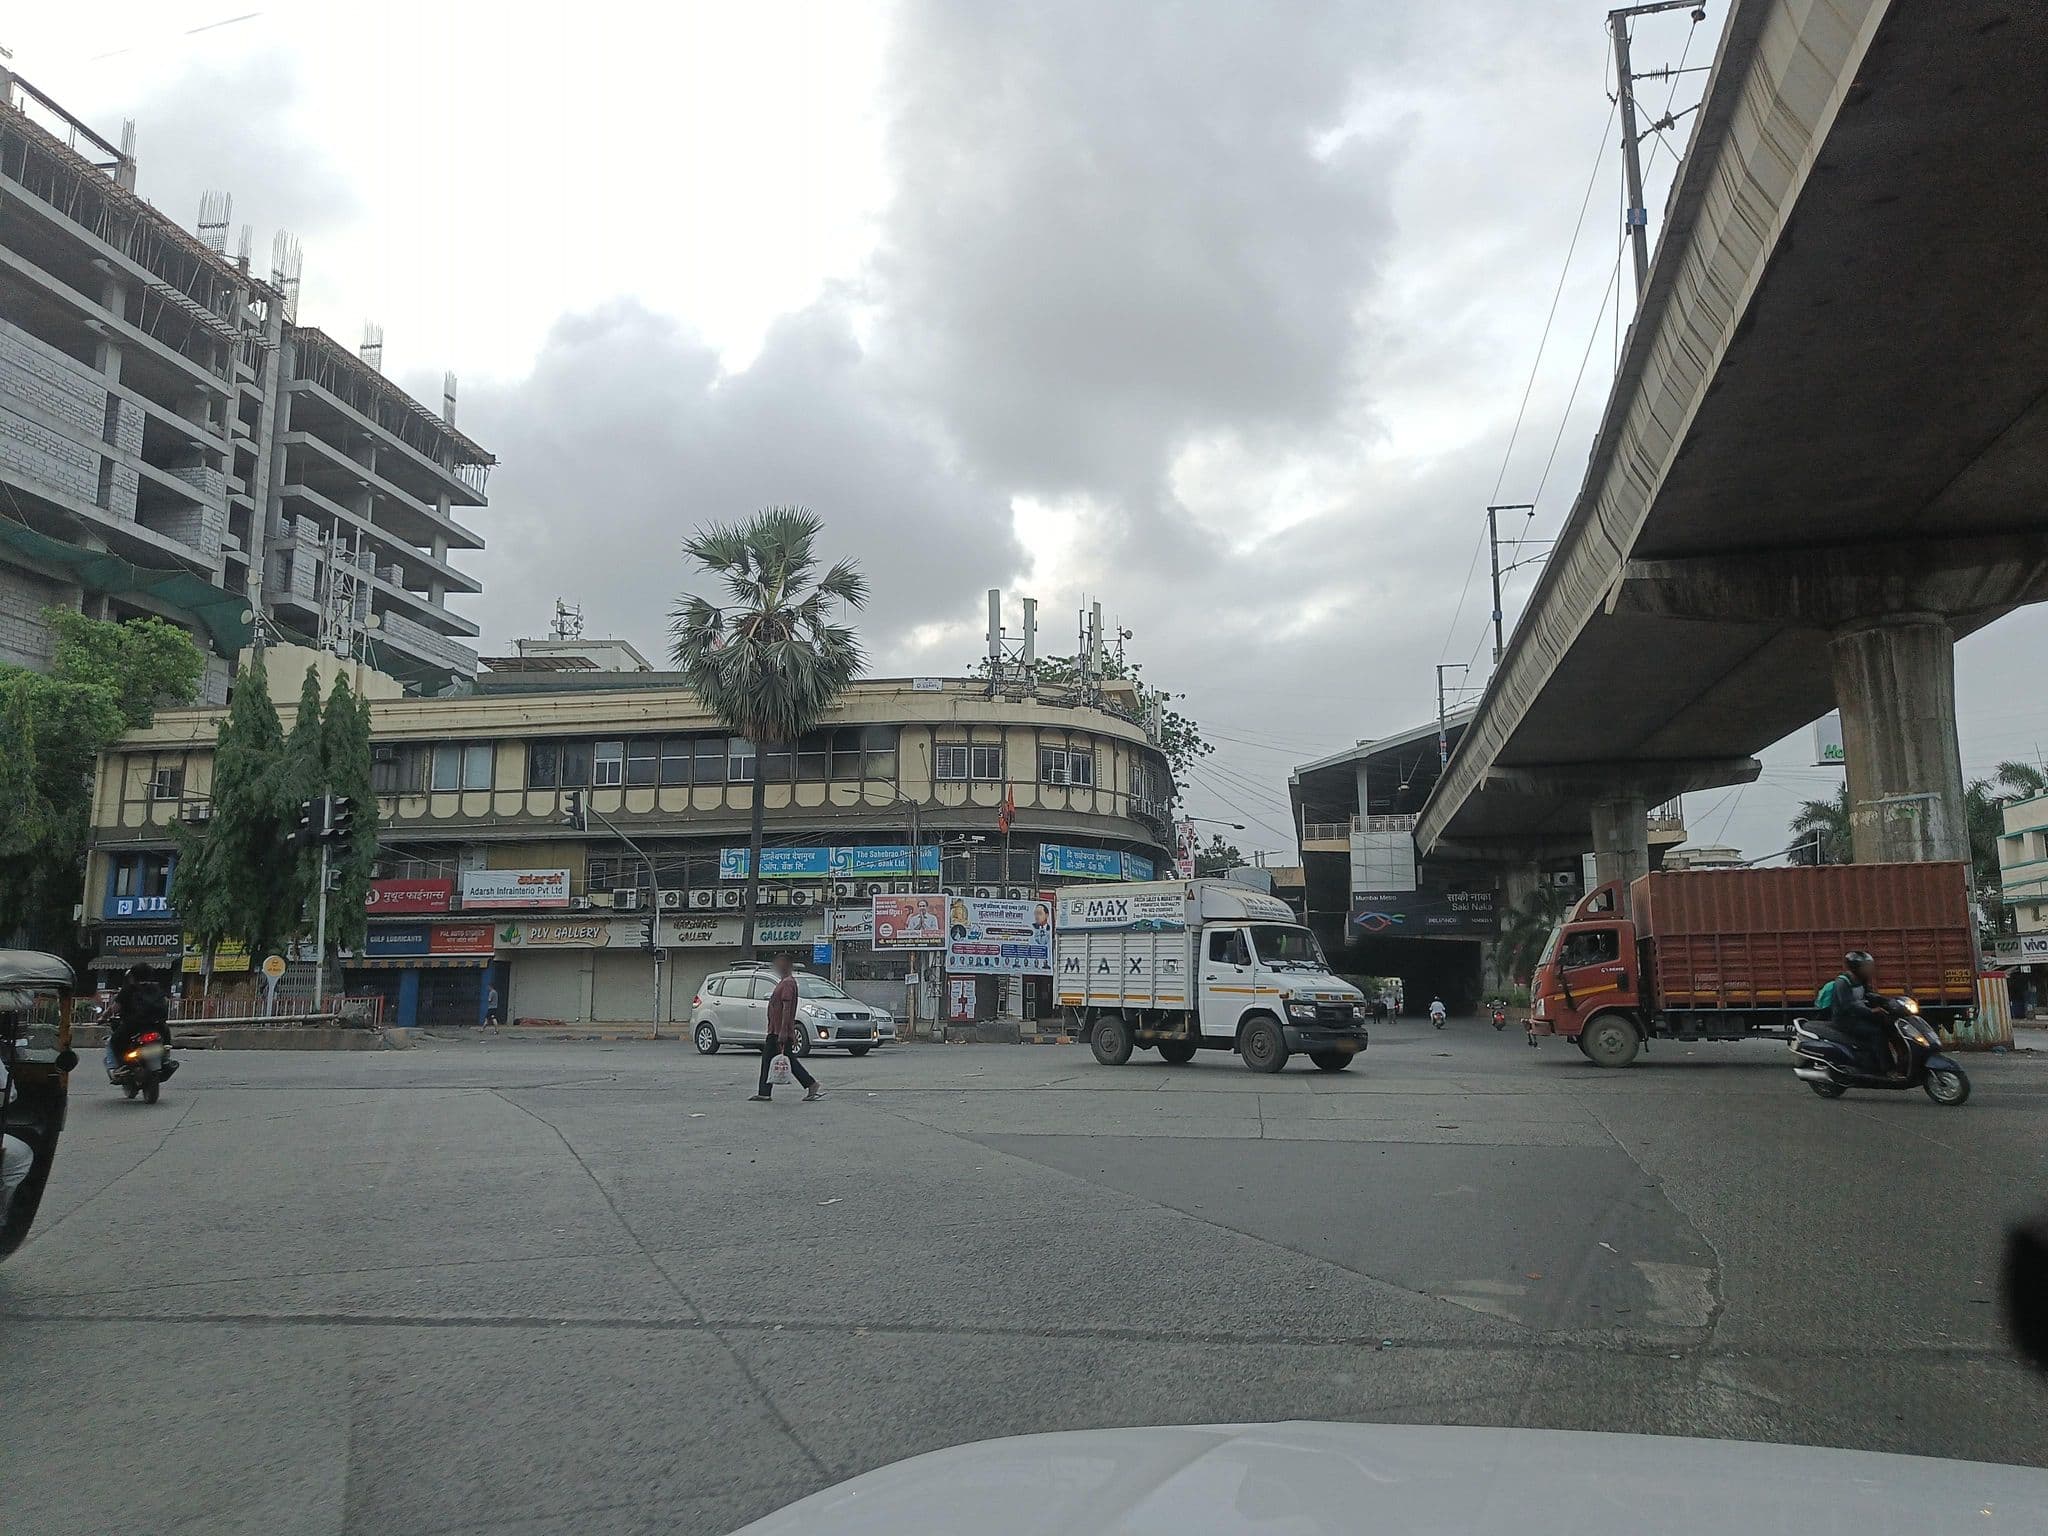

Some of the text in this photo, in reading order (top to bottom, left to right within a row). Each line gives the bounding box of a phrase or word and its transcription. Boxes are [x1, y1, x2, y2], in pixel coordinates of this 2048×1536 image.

[1824, 744, 1845, 759] Ho
[856, 850, 868, 858] The
[470, 886, 495, 896] Adarsh
[537, 886, 549, 896] Pvt
[551, 886, 563, 895] Ltd
[1086, 899, 1128, 917] MAX
[1452, 903, 1469, 911] Saki
[530, 927, 601, 939] PLY GALLERY
[678, 931, 713, 943] GALLERY
[759, 931, 802, 943] GALLERY
[105, 934, 135, 947] PREM
[137, 934, 179, 946] MOTORS
[2024, 938, 2048, 951] vivo
[1064, 957, 1142, 974] M A X
